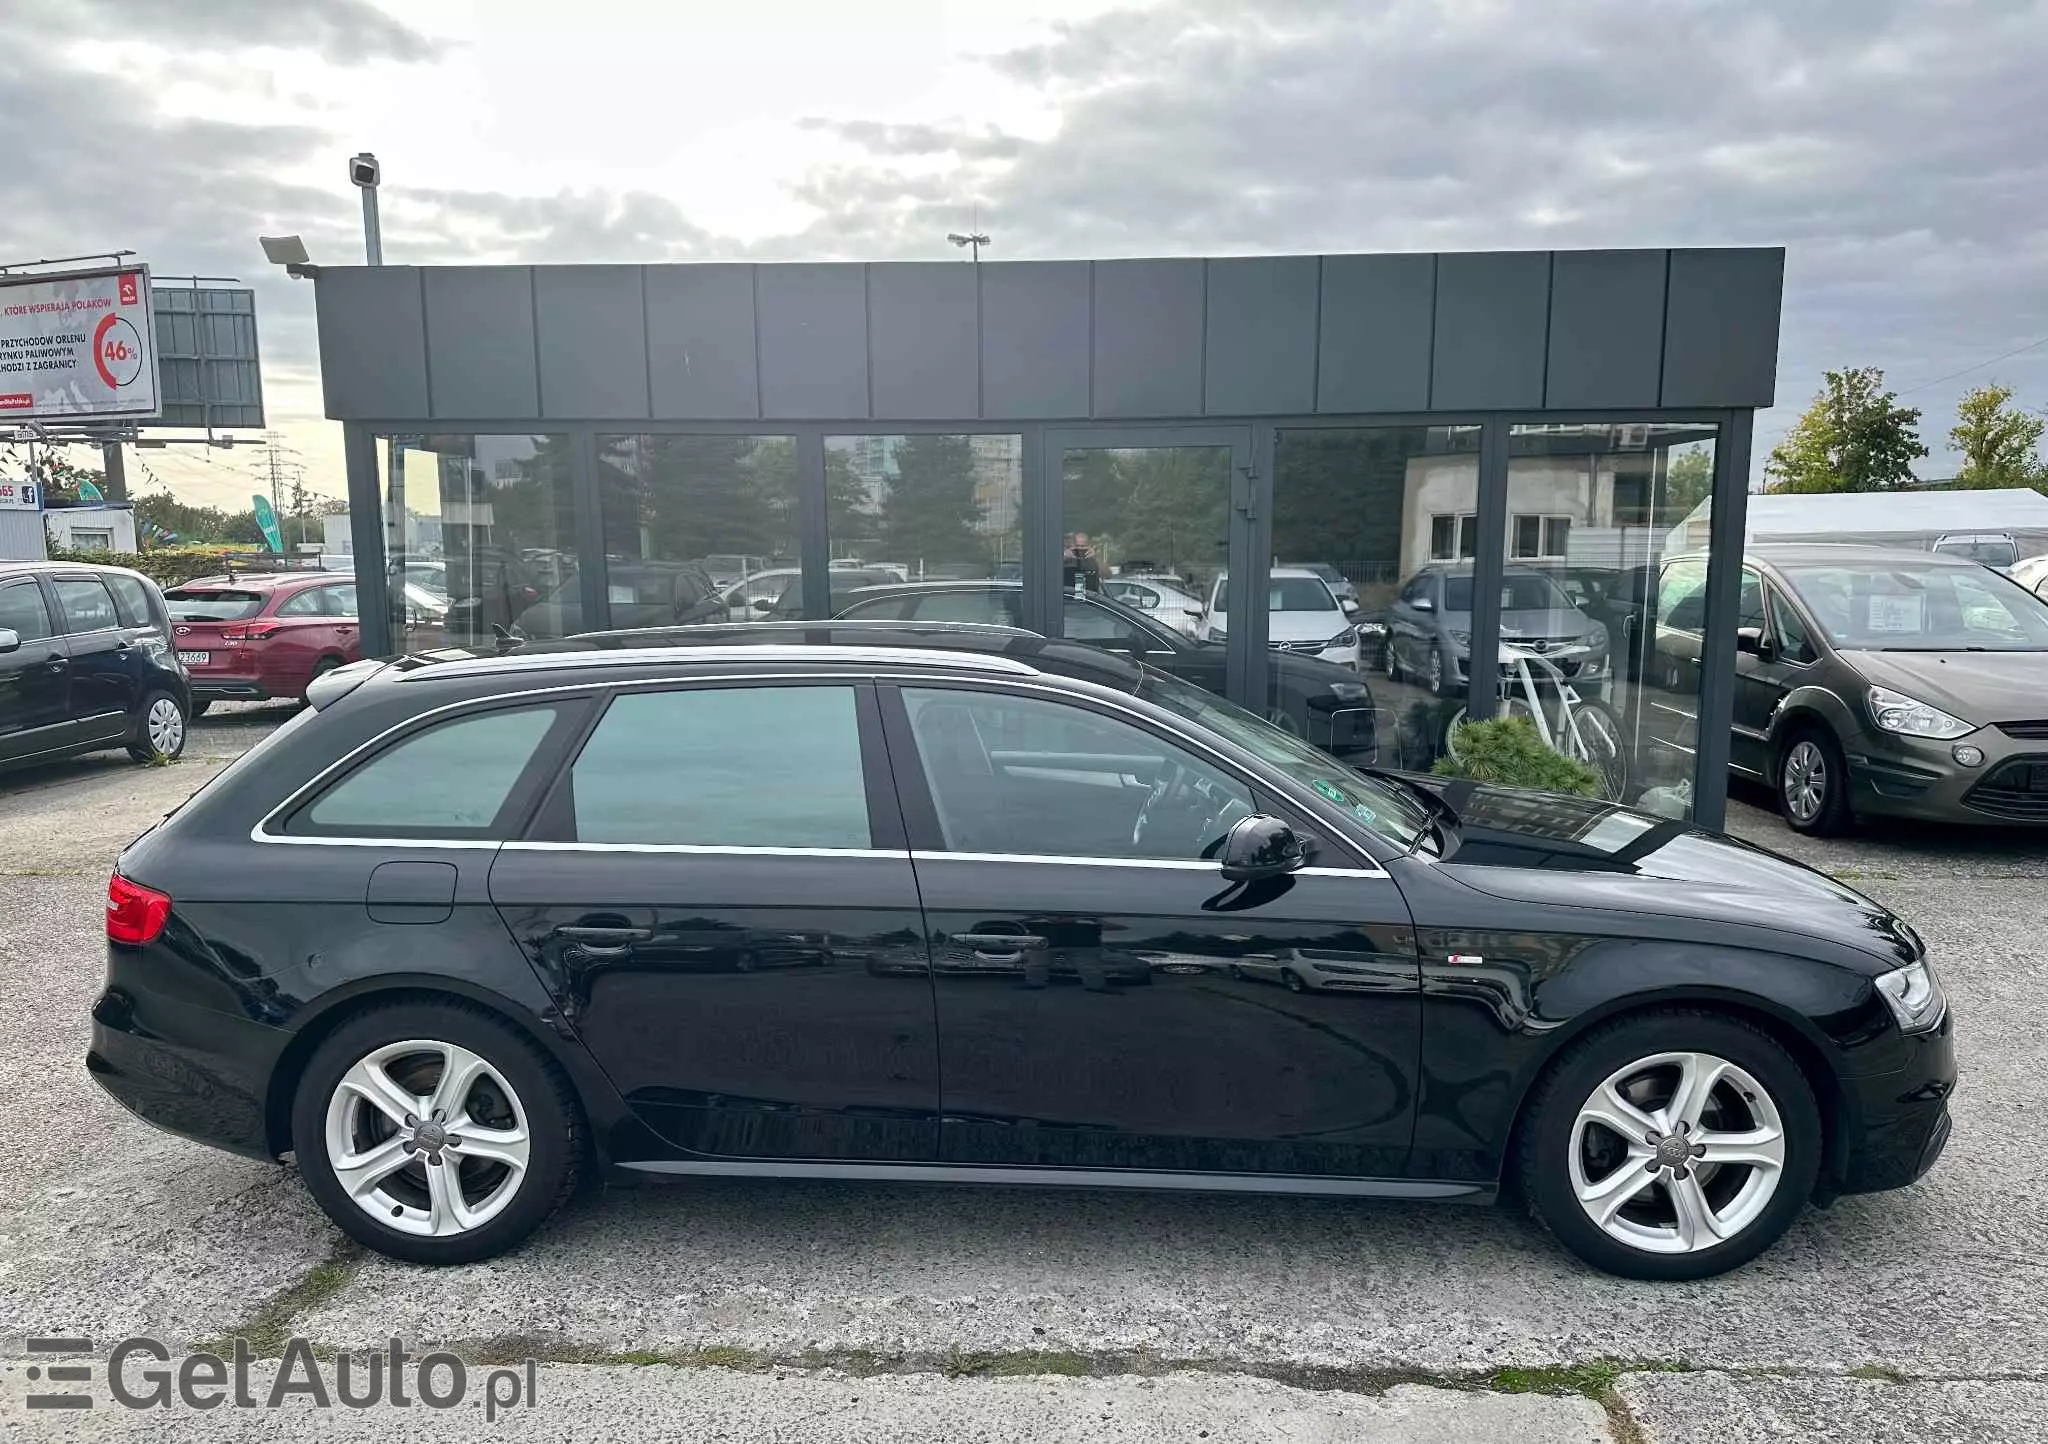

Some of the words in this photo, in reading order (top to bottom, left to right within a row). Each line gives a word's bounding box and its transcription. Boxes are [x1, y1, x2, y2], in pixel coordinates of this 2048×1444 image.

[55, 333, 86, 345] ORLENU
[25, 346, 74, 359] PALIWOWYM
[26, 361, 31, 371] Z
[33, 358, 77, 370] ZAGRANICY
